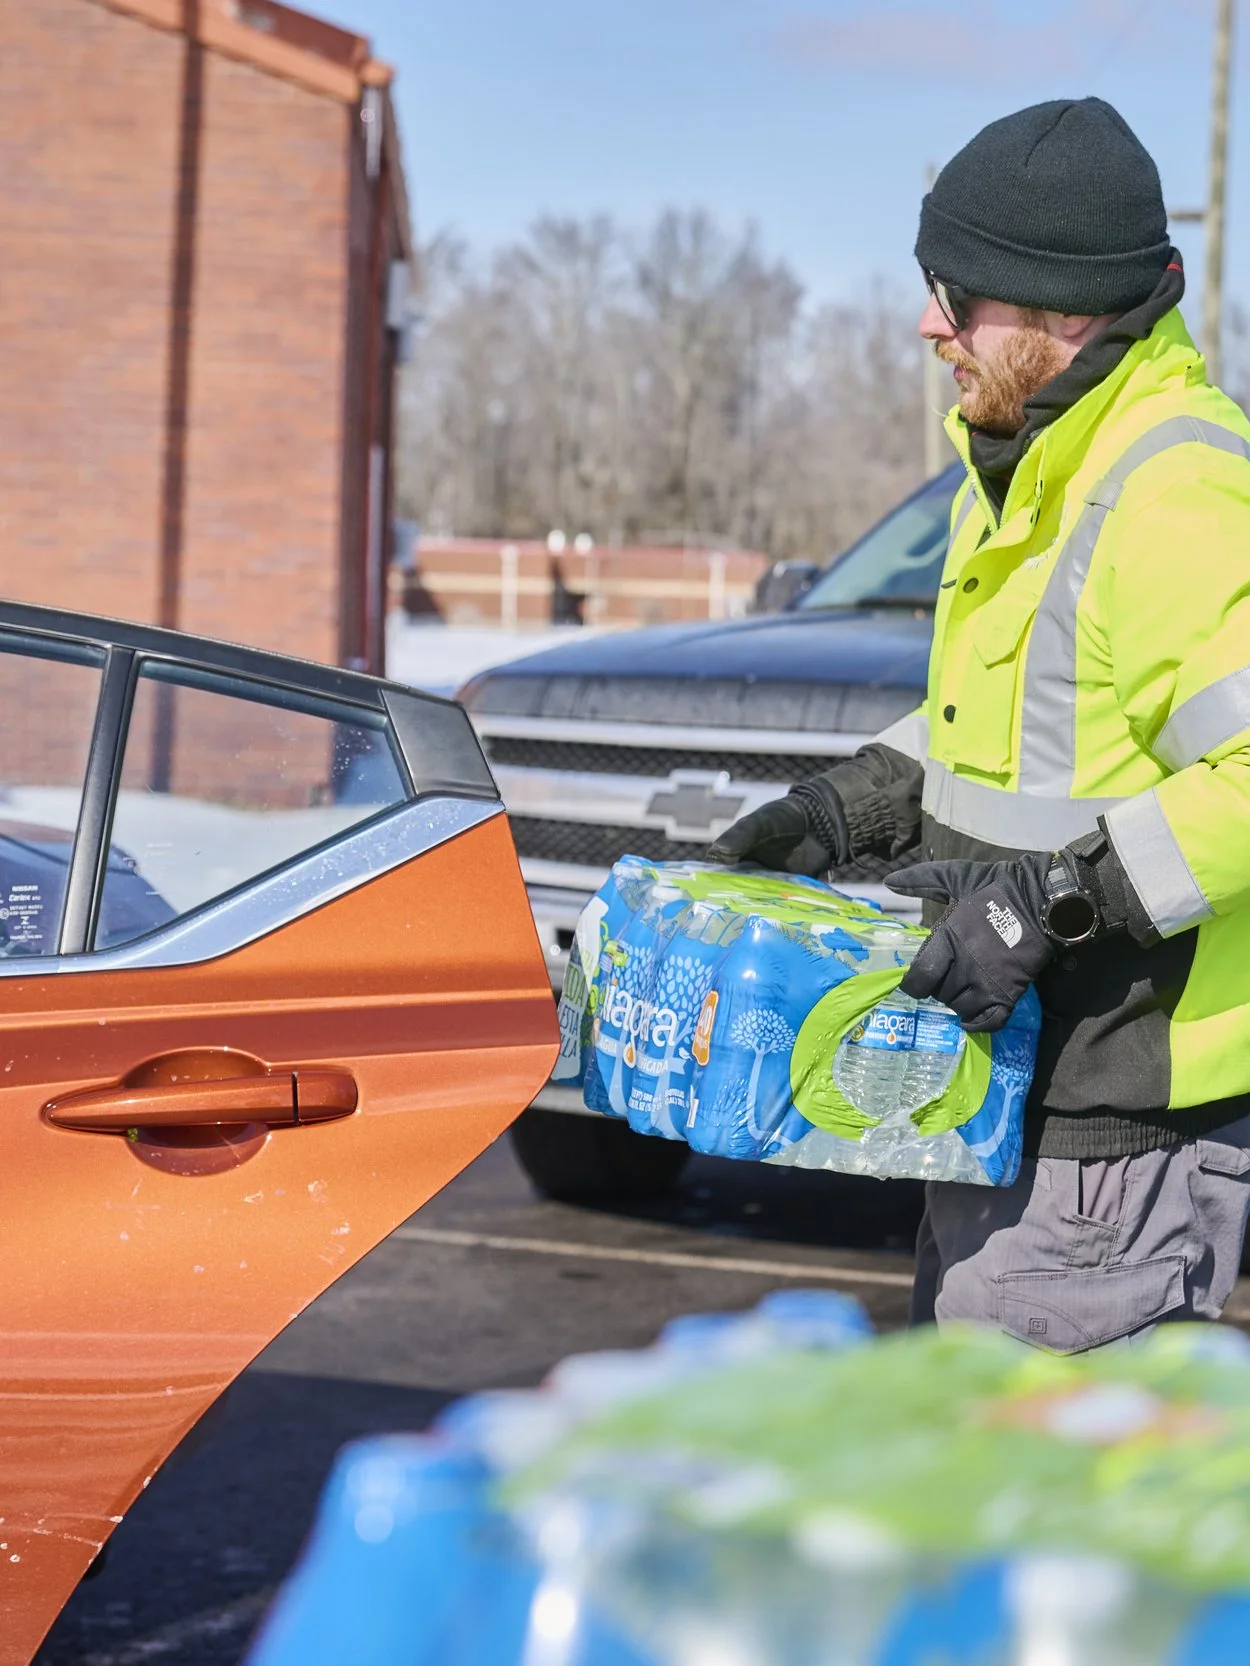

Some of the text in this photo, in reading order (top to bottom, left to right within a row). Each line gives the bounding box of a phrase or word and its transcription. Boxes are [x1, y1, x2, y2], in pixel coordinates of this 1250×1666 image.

[986, 900, 1012, 932] NORTH
[986, 912, 1006, 936] FACE
[1003, 906, 1018, 926] THE
